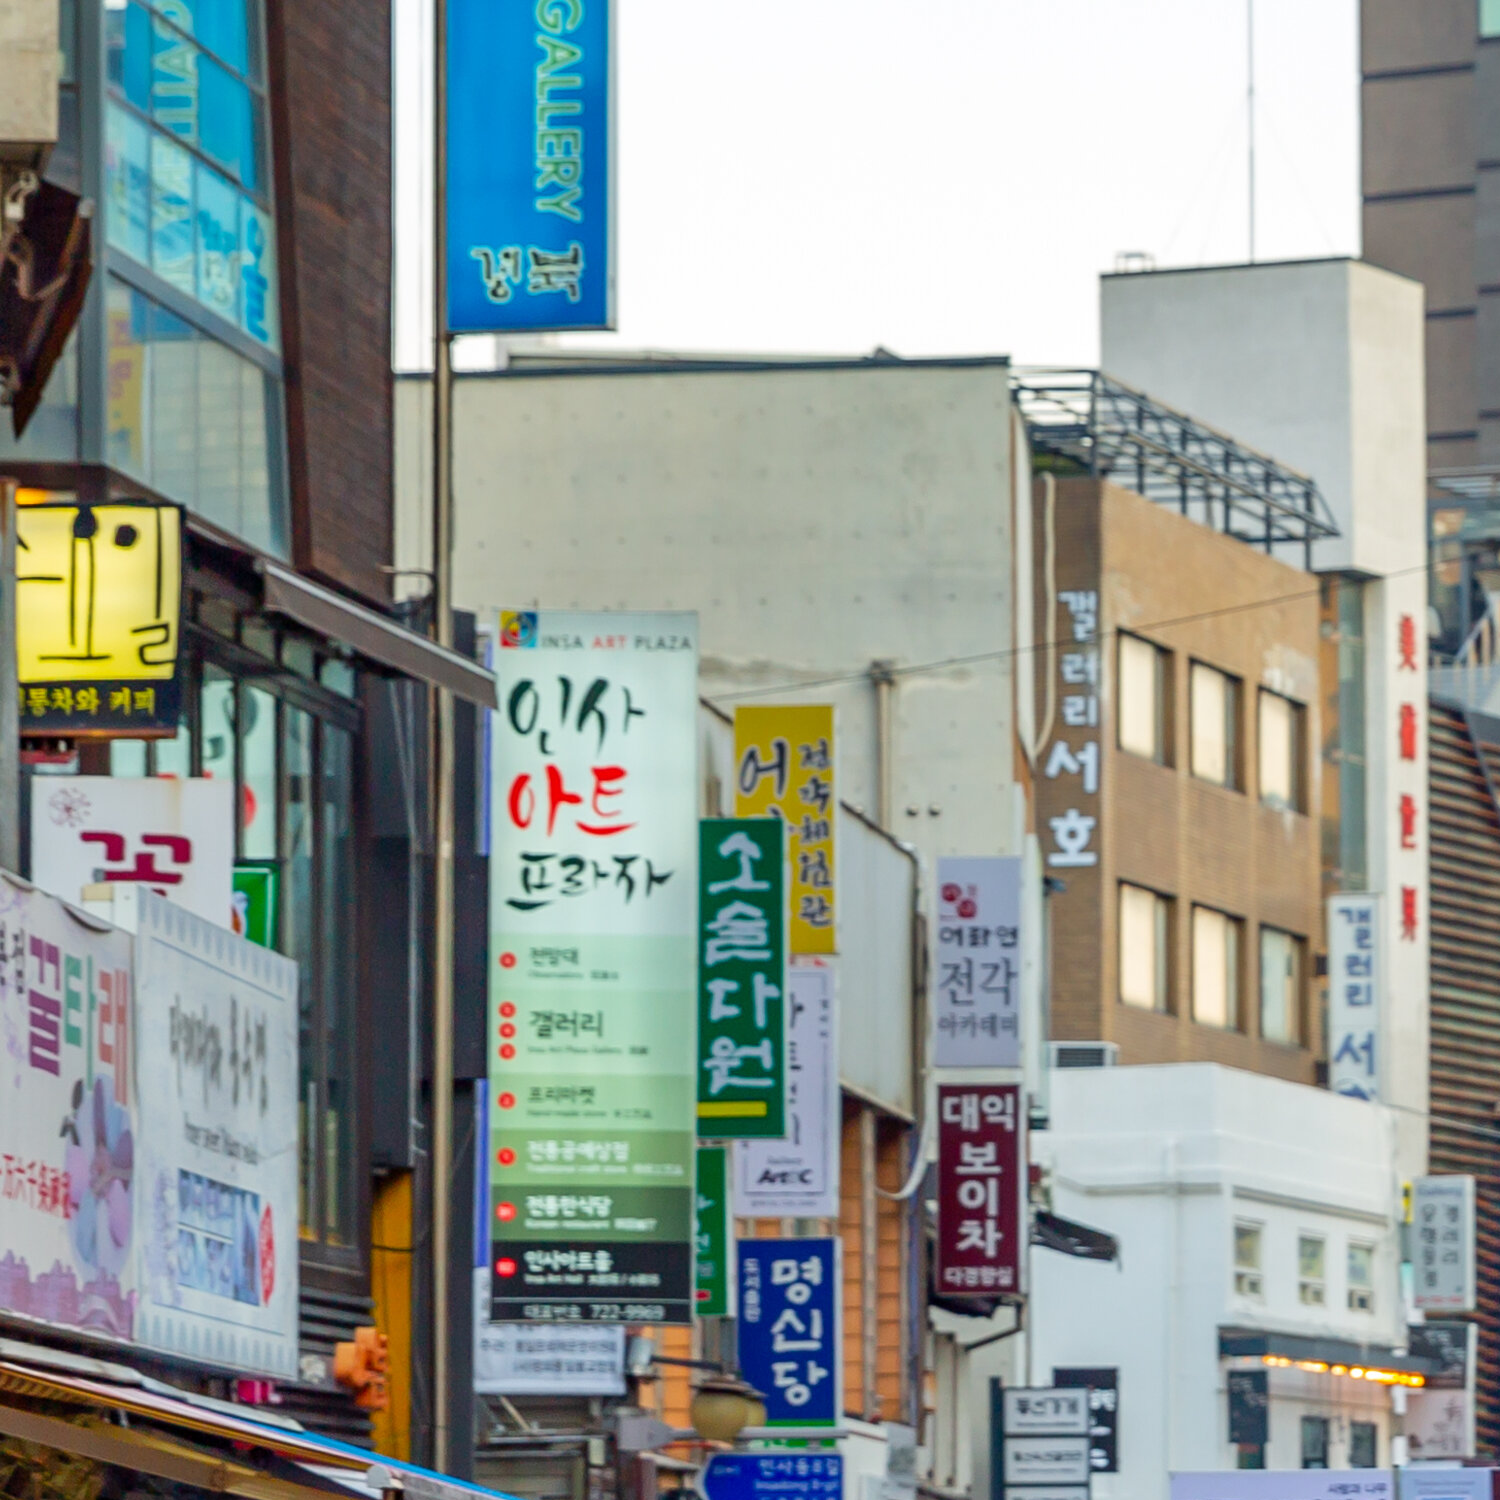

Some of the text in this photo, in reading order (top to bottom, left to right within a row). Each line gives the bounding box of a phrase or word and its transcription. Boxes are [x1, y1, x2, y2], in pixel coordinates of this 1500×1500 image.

[535, 0, 583, 222] GALLERY
[541, 636, 692, 650] INSA ART PLAZA
[1057, 590, 1098, 727] 갤러리
[20, 687, 156, 716] 통차와 커피
[507, 675, 646, 756] 인사
[508, 764, 638, 837] 아트
[1045, 740, 1098, 867] 서호
[505, 852, 675, 911] 프라자
[703, 831, 781, 1096] 소슬다원
[940, 956, 1018, 1006] 전각
[529, 1010, 604, 1039] 갤러리
[938, 1012, 1018, 1039] 아카데미
[942, 1093, 1015, 1132] 대익
[954, 1141, 1003, 1258] 보이차
[769, 1255, 829, 1407] 명신당
